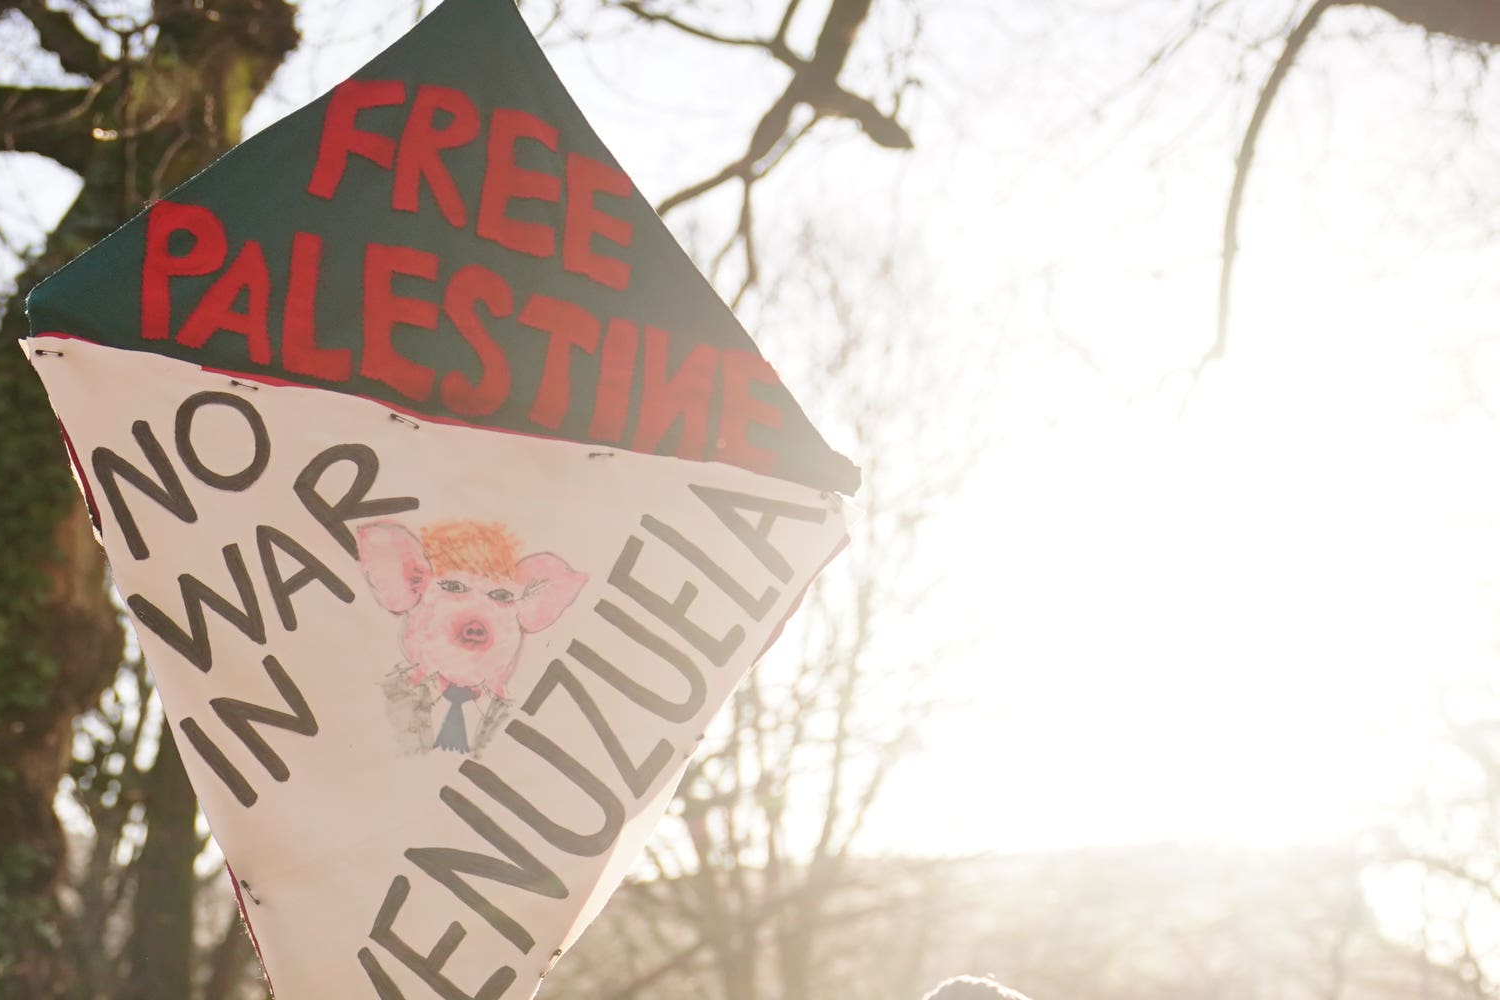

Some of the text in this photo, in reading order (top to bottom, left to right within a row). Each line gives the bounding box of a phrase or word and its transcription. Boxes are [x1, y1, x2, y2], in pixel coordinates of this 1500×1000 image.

[307, 79, 636, 292] FREE
[141, 201, 784, 474] PALESTINE
[91, 391, 271, 561] NO
[127, 443, 420, 673] WAR
[180, 655, 319, 808] IN
